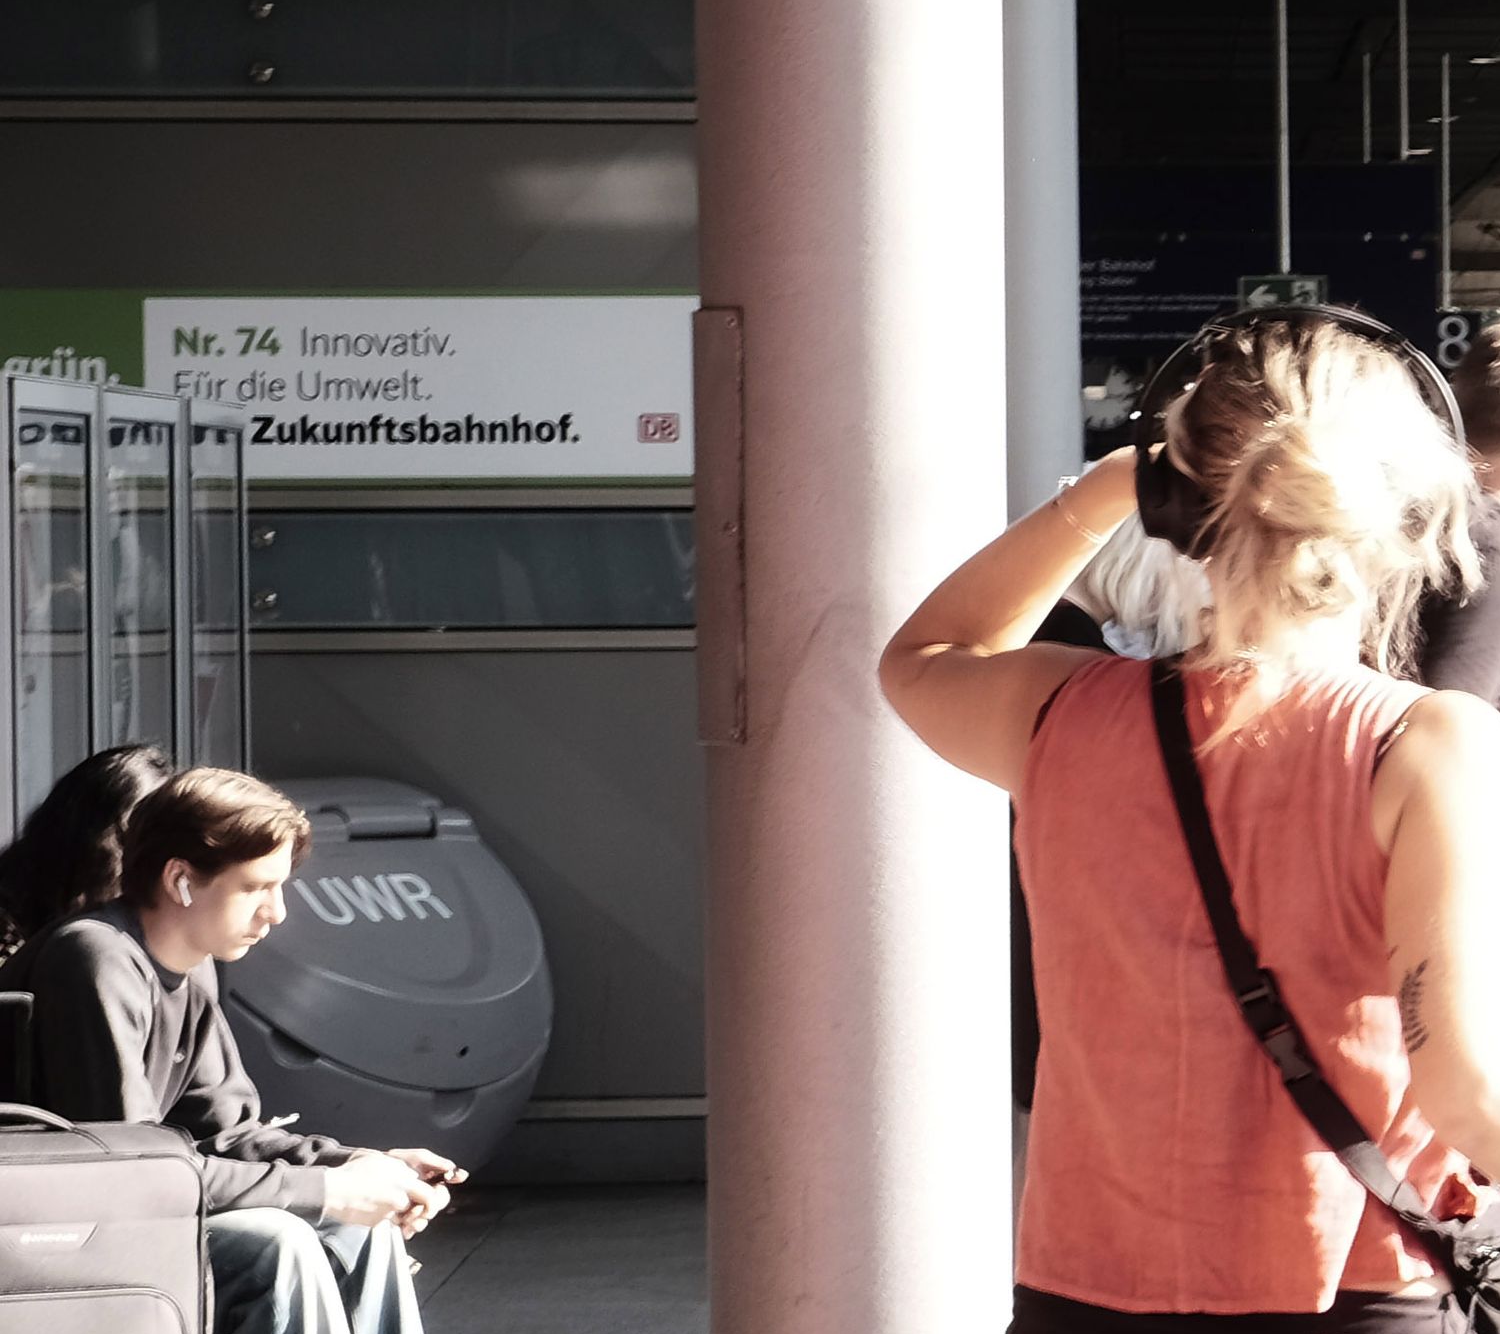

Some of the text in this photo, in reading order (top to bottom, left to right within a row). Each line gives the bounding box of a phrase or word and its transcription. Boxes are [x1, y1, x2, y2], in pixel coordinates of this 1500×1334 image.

[173, 327, 456, 358] Nr. 74 Innovativ.
[1438, 315, 1471, 368] 8
[173, 370, 433, 402] Für die Umwelt.
[250, 414, 580, 445] Zukunftsbahnhof.
[292, 872, 454, 925] UWR
